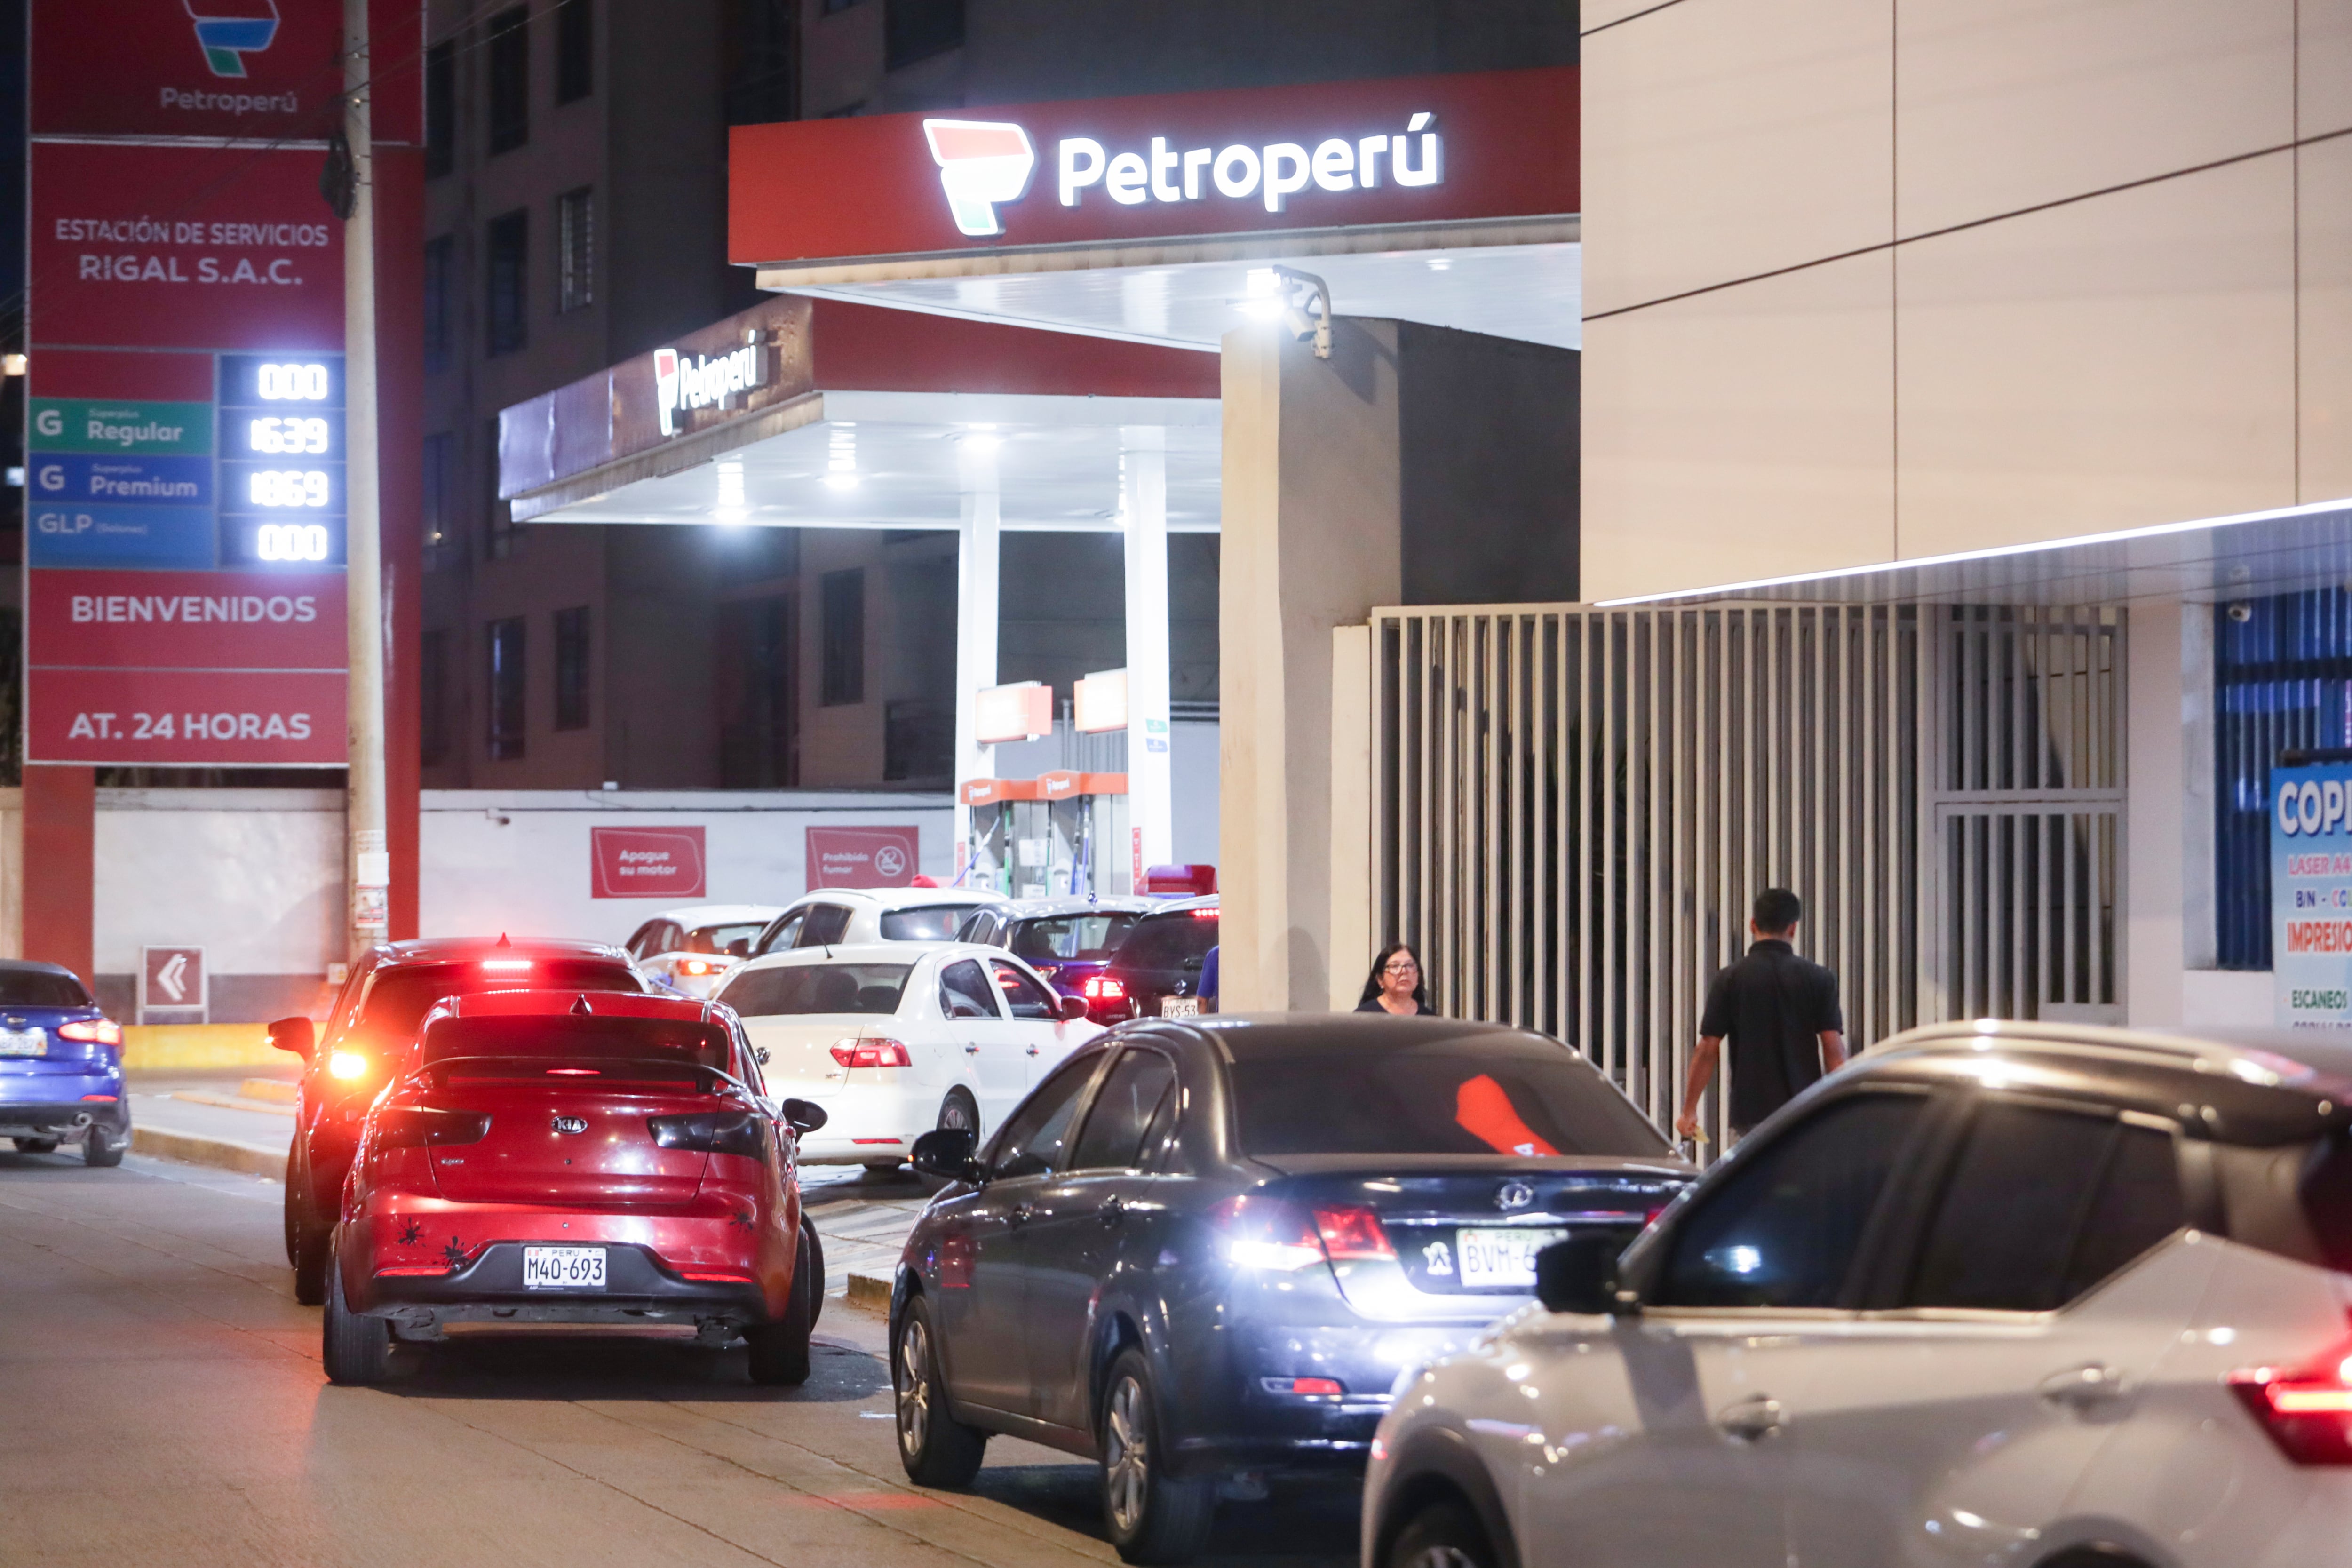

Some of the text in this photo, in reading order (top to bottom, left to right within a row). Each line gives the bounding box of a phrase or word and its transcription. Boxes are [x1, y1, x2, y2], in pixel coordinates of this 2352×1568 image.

[161, 87, 298, 116] Petroperú
[1059, 112, 1438, 213] Petroperú
[56, 215, 329, 247] ESTACIÓN DE SERVICIOS
[79, 255, 303, 285] RIGAL S.A.C.
[680, 329, 756, 410] Petroperú
[37, 409, 183, 446] G Regular
[40, 465, 198, 497] G Premium
[38, 513, 93, 533] GLP
[72, 596, 317, 623] BIENVENIDOS
[68, 712, 311, 740] AT. 24 HORAS
[619, 849, 670, 864] Apague
[822, 852, 869, 862] Prohibido
[2289, 857, 2330, 875] LASER
[619, 864, 677, 875] su motor
[822, 864, 853, 874] fumar
[2288, 921, 2352, 953] IMPRESIO
[2292, 989, 2347, 1009] ESCANEOS
[1163, 1005, 1196, 1018] BYS-53
[557, 1119, 582, 1130] KIA
[1495, 1231, 1532, 1242] PERU
